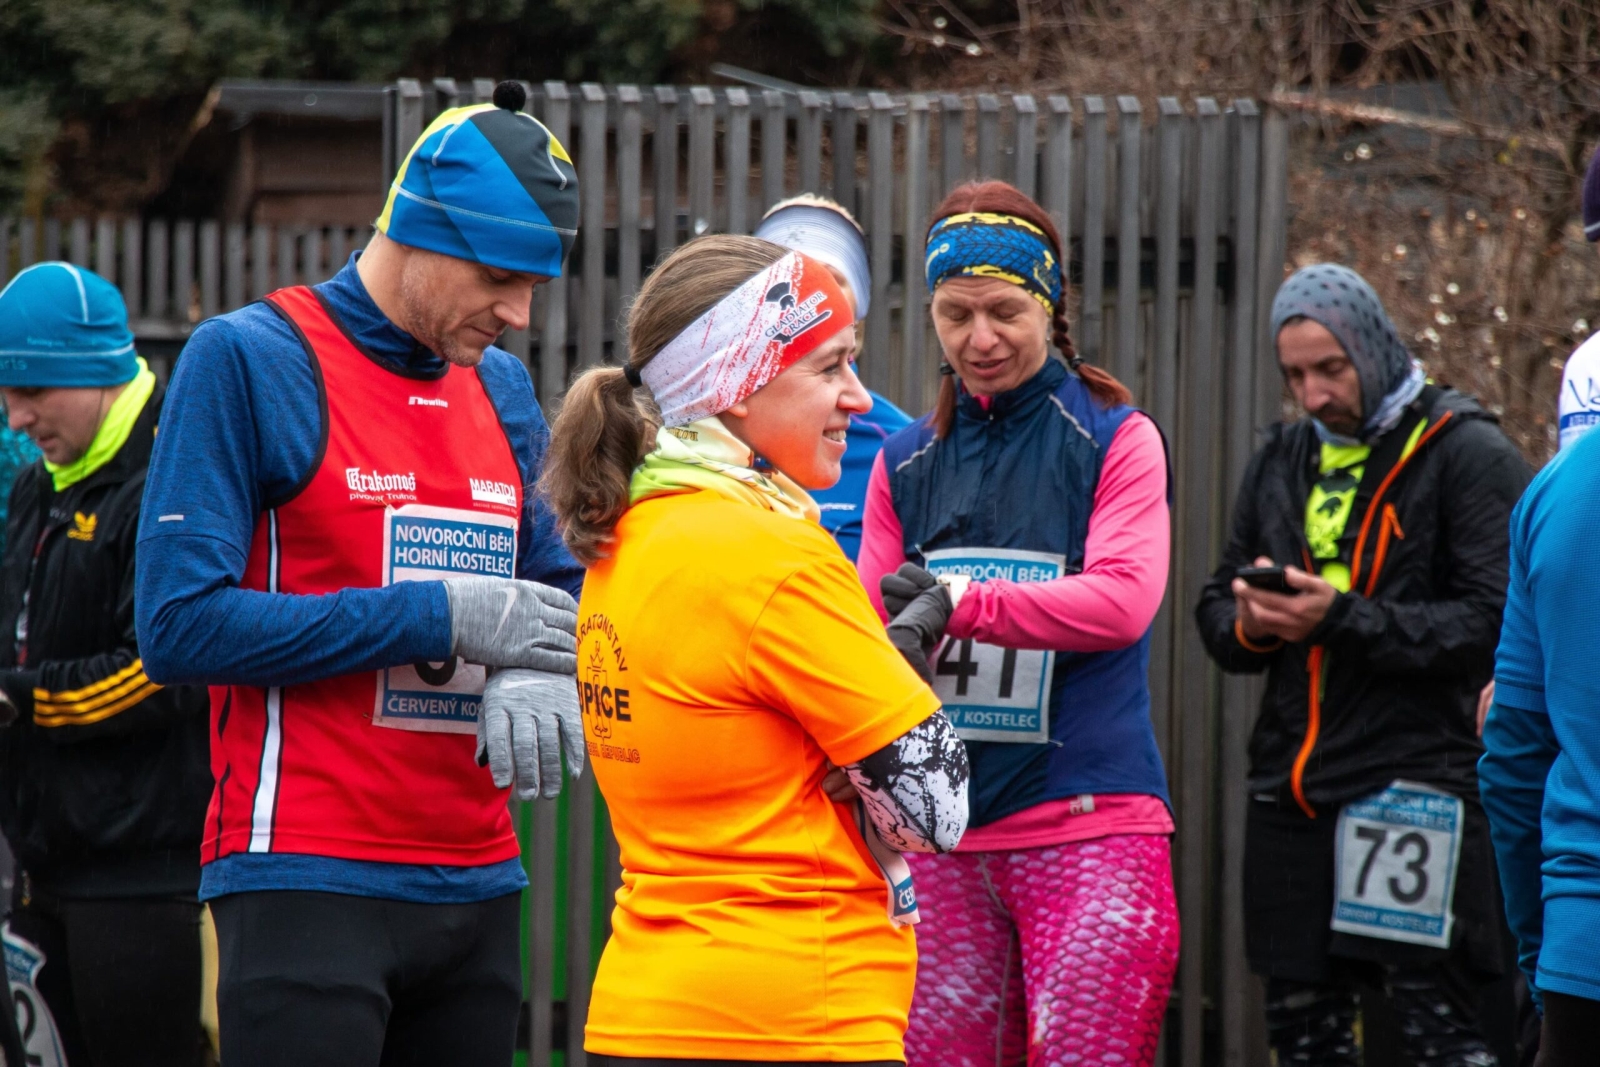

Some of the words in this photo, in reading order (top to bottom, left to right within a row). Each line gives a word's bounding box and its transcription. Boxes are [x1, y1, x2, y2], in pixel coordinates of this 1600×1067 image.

[765, 292, 825, 337] GLADIATOR
[787, 309, 816, 333] RACE
[395, 524, 487, 550] NOVOROČNÍ
[489, 531, 512, 553] BĚH
[394, 546, 448, 567] HORNÍ
[451, 551, 511, 575] KOSTELEC
[1017, 566, 1053, 583] BĚH
[387, 694, 458, 716] ČERVENÝ
[964, 711, 1037, 728] KOSTELEC
[1355, 825, 1431, 906] 73
